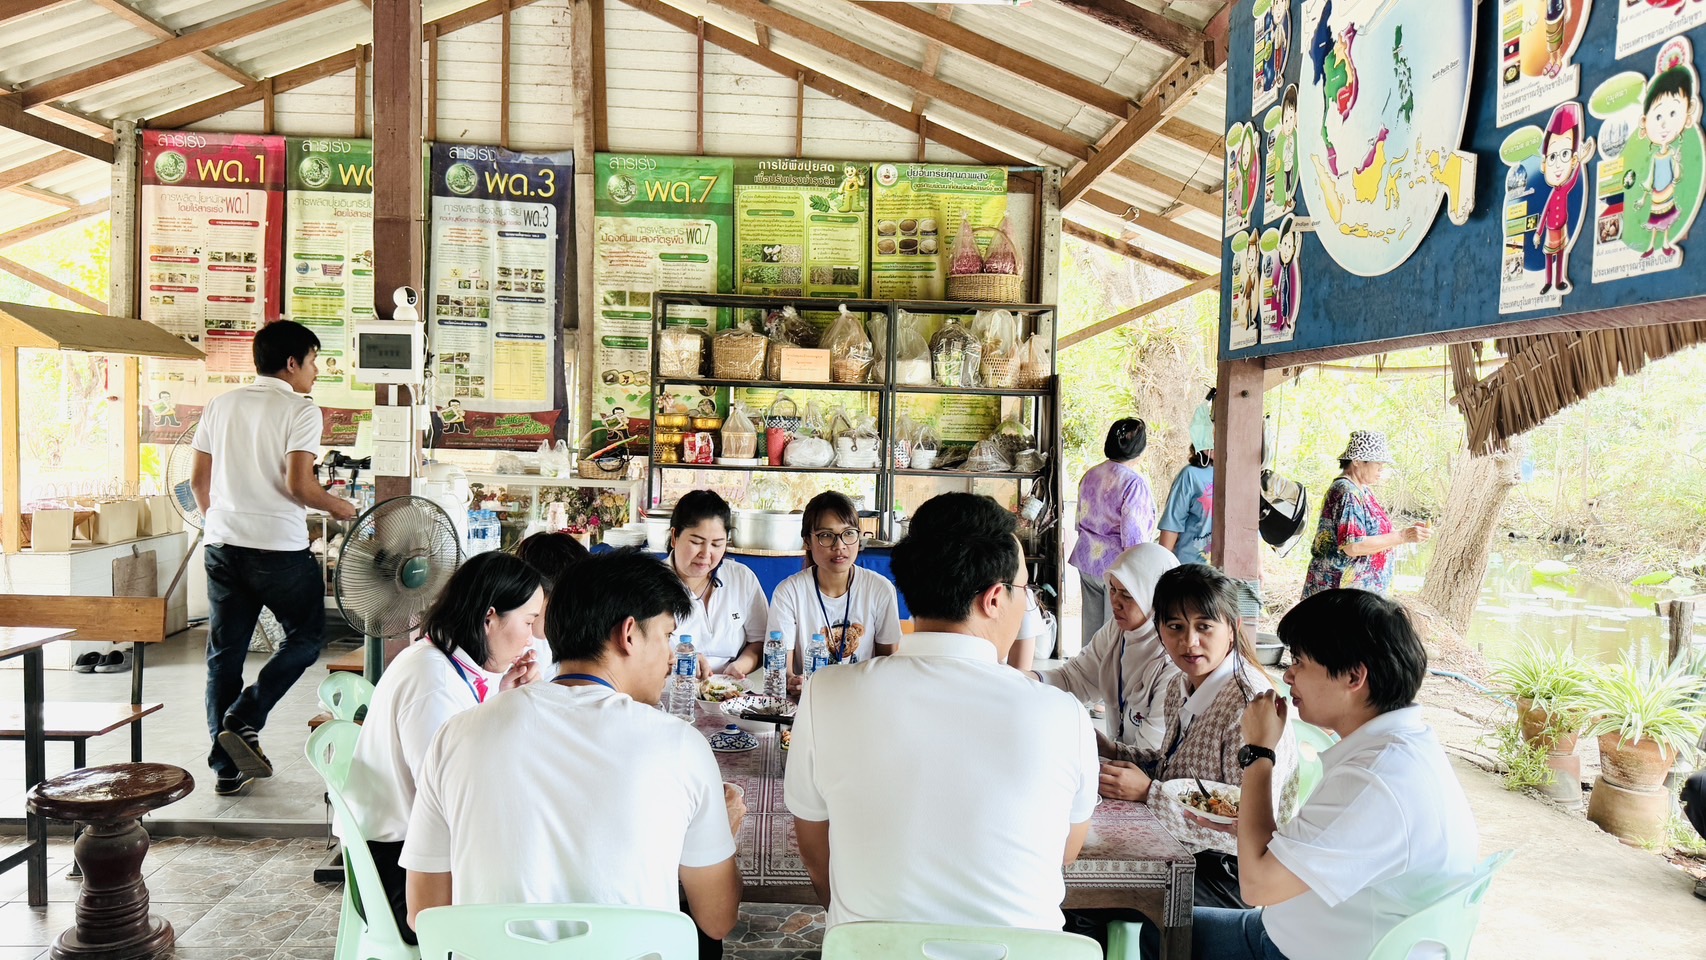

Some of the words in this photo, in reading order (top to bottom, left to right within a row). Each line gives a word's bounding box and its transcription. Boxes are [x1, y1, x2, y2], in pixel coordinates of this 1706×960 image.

[158, 132, 206, 148] สารเร่ง
[302, 139, 352, 154] สารเร่ง
[449, 146, 497, 162] สารเร่ง
[609, 156, 657, 171] สารเร่ง
[196, 154, 265, 184] พด.1
[484, 168, 556, 198] พด.3
[645, 175, 719, 204] พด.7
[225, 192, 250, 215] พด.1
[523, 206, 549, 228] พด.3
[685, 223, 711, 246] พด.7
